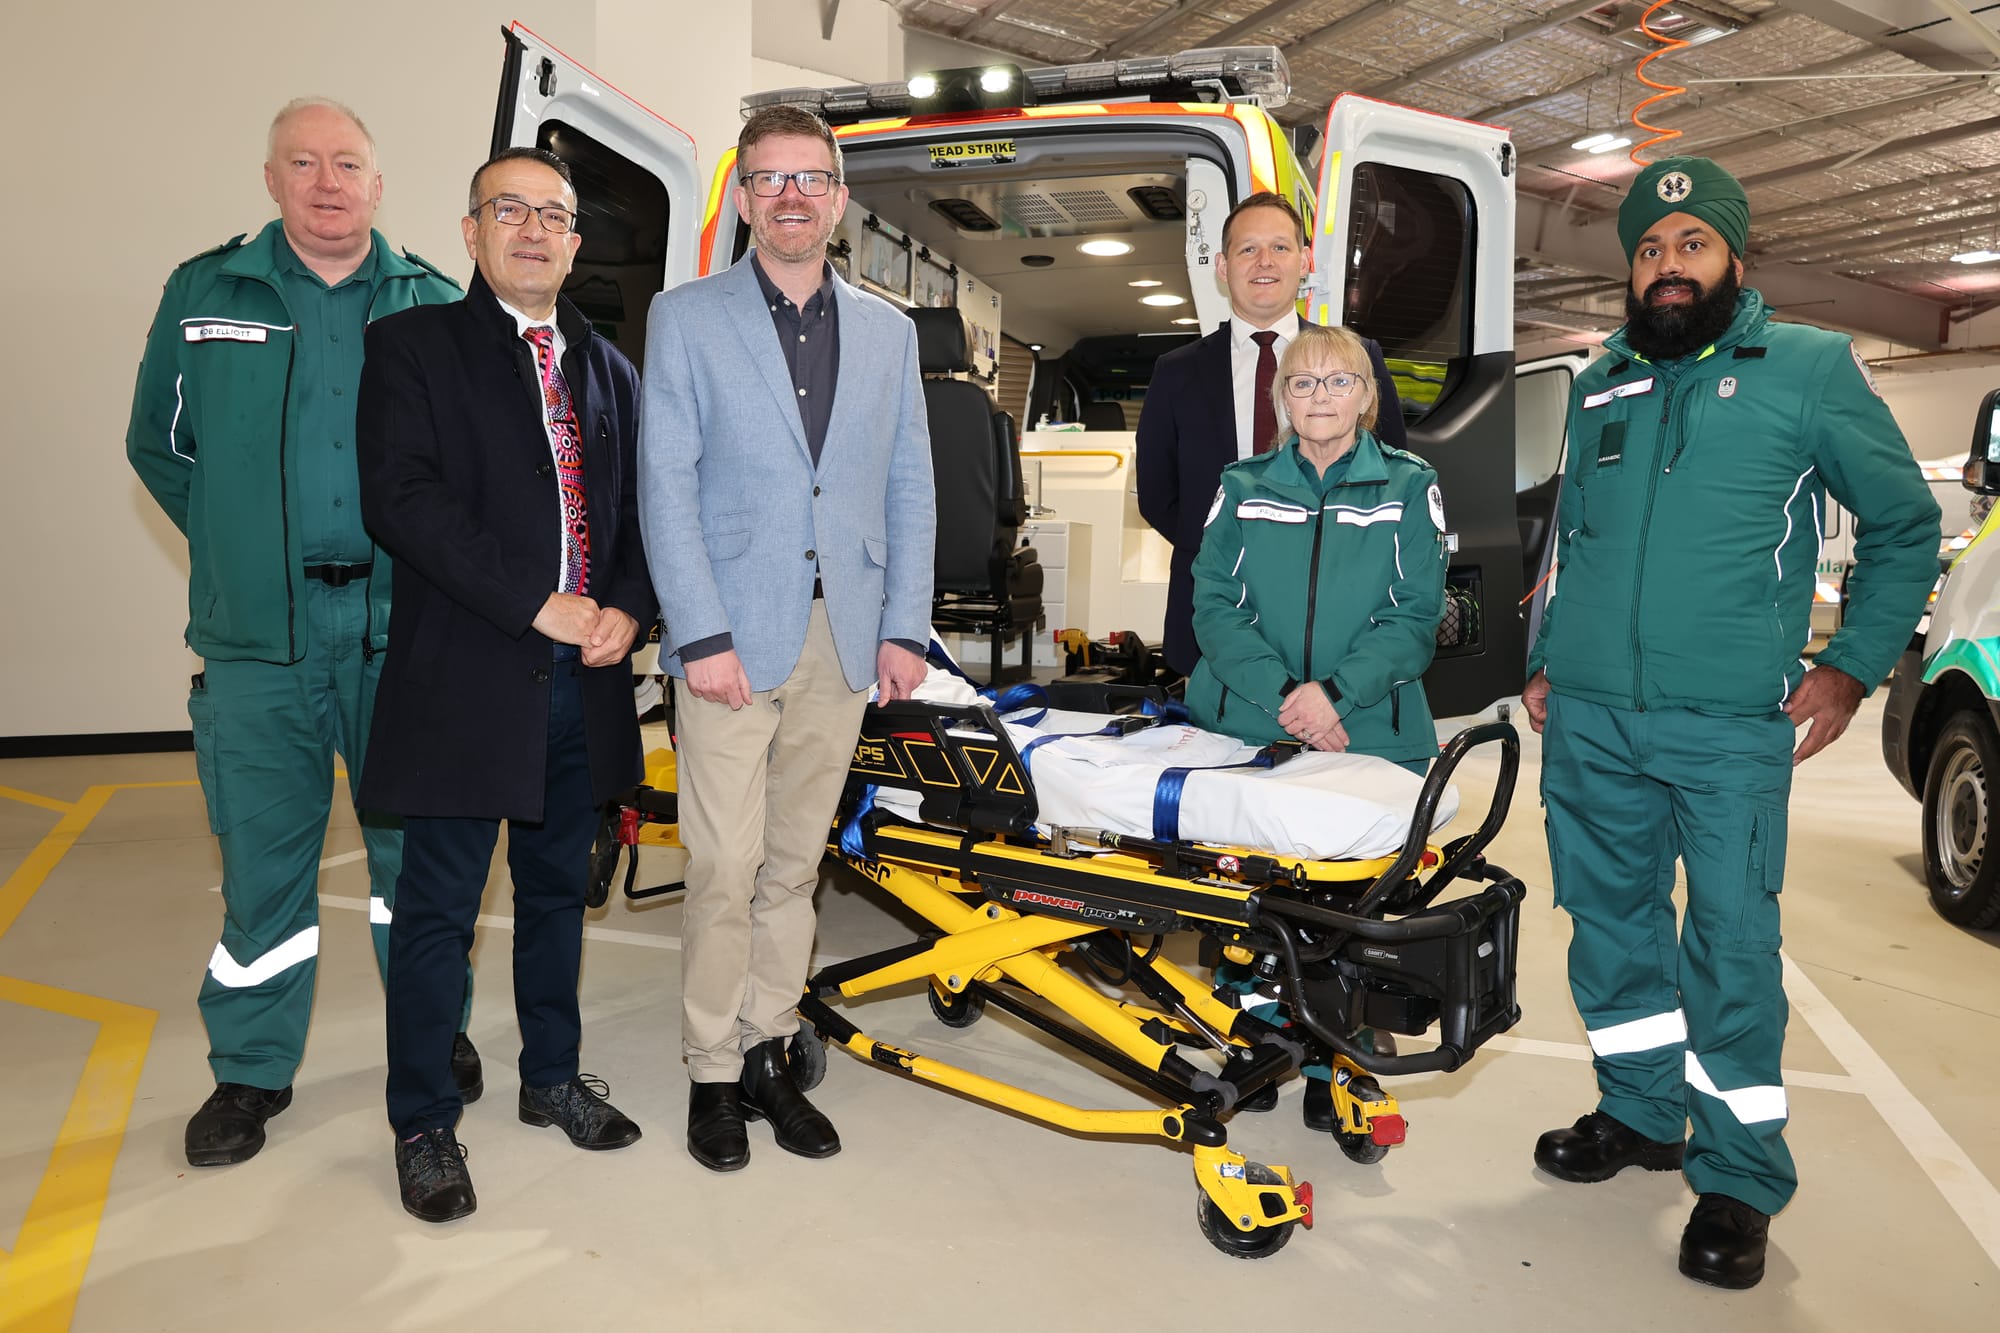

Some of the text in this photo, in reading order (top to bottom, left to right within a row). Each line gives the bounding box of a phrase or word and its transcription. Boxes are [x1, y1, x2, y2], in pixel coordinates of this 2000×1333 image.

[928, 142, 1016, 156] HEAD STRIKE
[216, 328, 251, 337] ELLIOTT
[1012, 889, 1085, 911] power
[1083, 907, 1117, 920] pro
